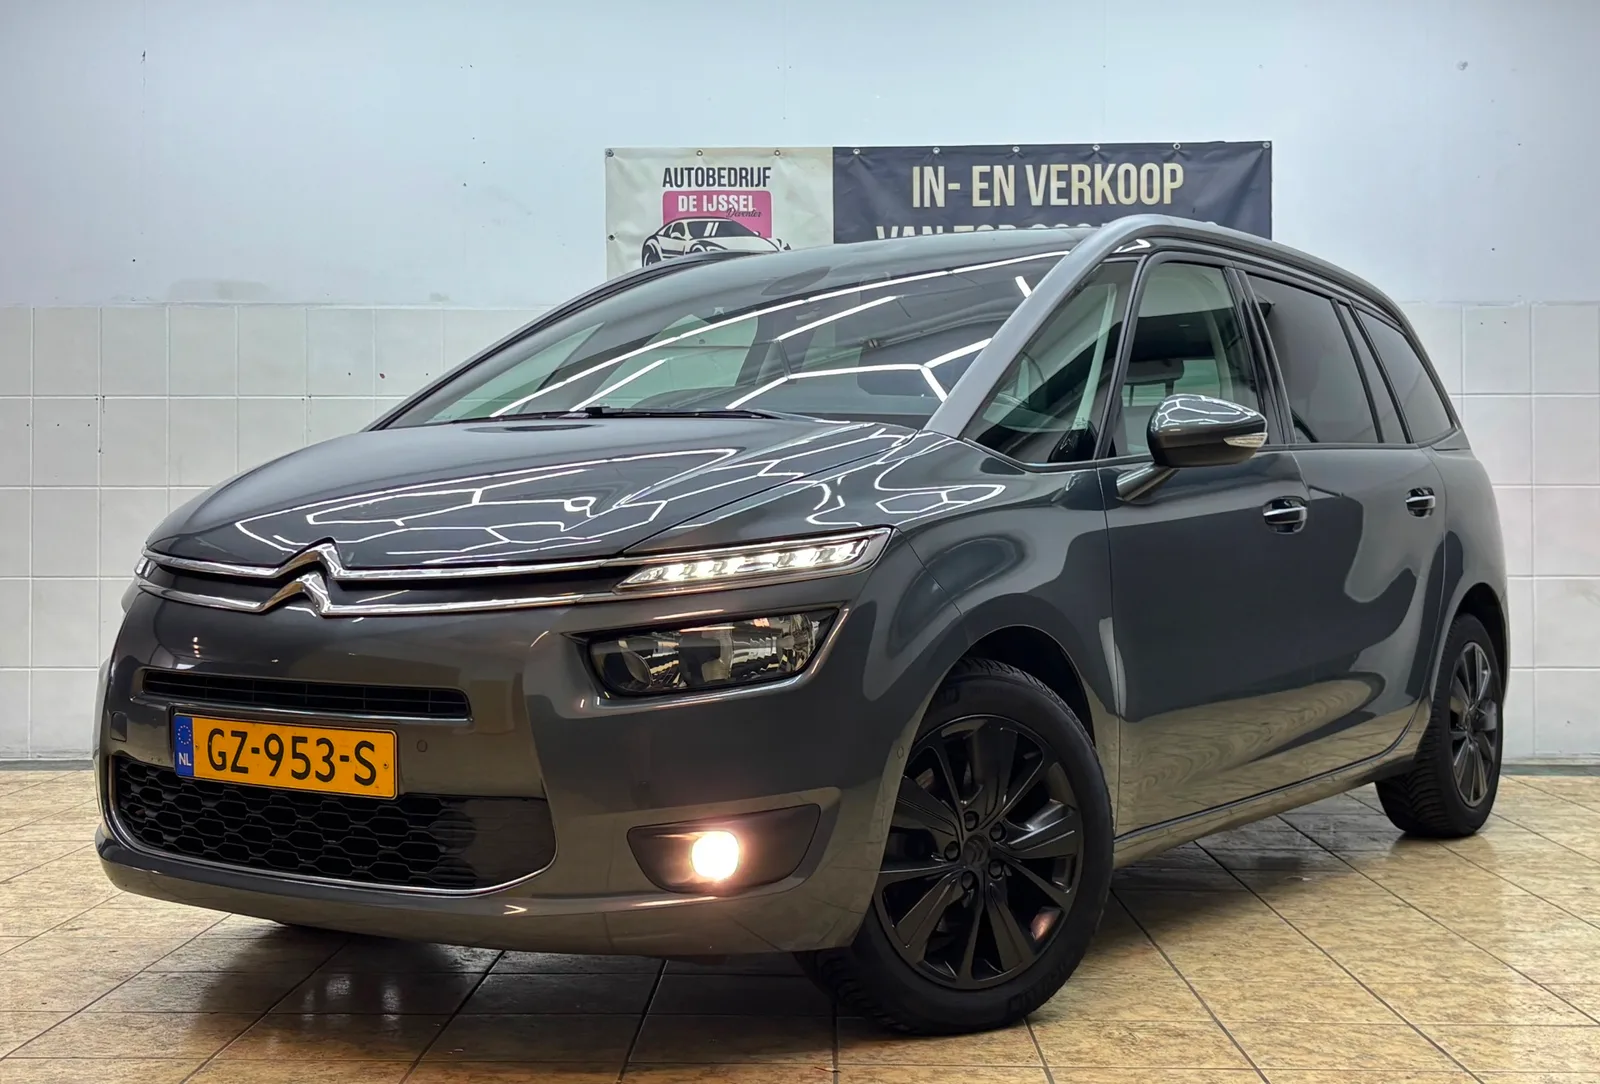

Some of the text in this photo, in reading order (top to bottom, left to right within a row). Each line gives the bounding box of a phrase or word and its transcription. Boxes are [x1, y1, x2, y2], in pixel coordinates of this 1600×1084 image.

[662, 167, 771, 188] AUTOBEDRIJF
[912, 162, 1184, 208] IN- EN VERKOOP
[678, 194, 754, 212] DE IJSSEL
[725, 207, 762, 218] Deventer
[178, 752, 192, 767] NL
[207, 728, 377, 787] GZ-953-S
